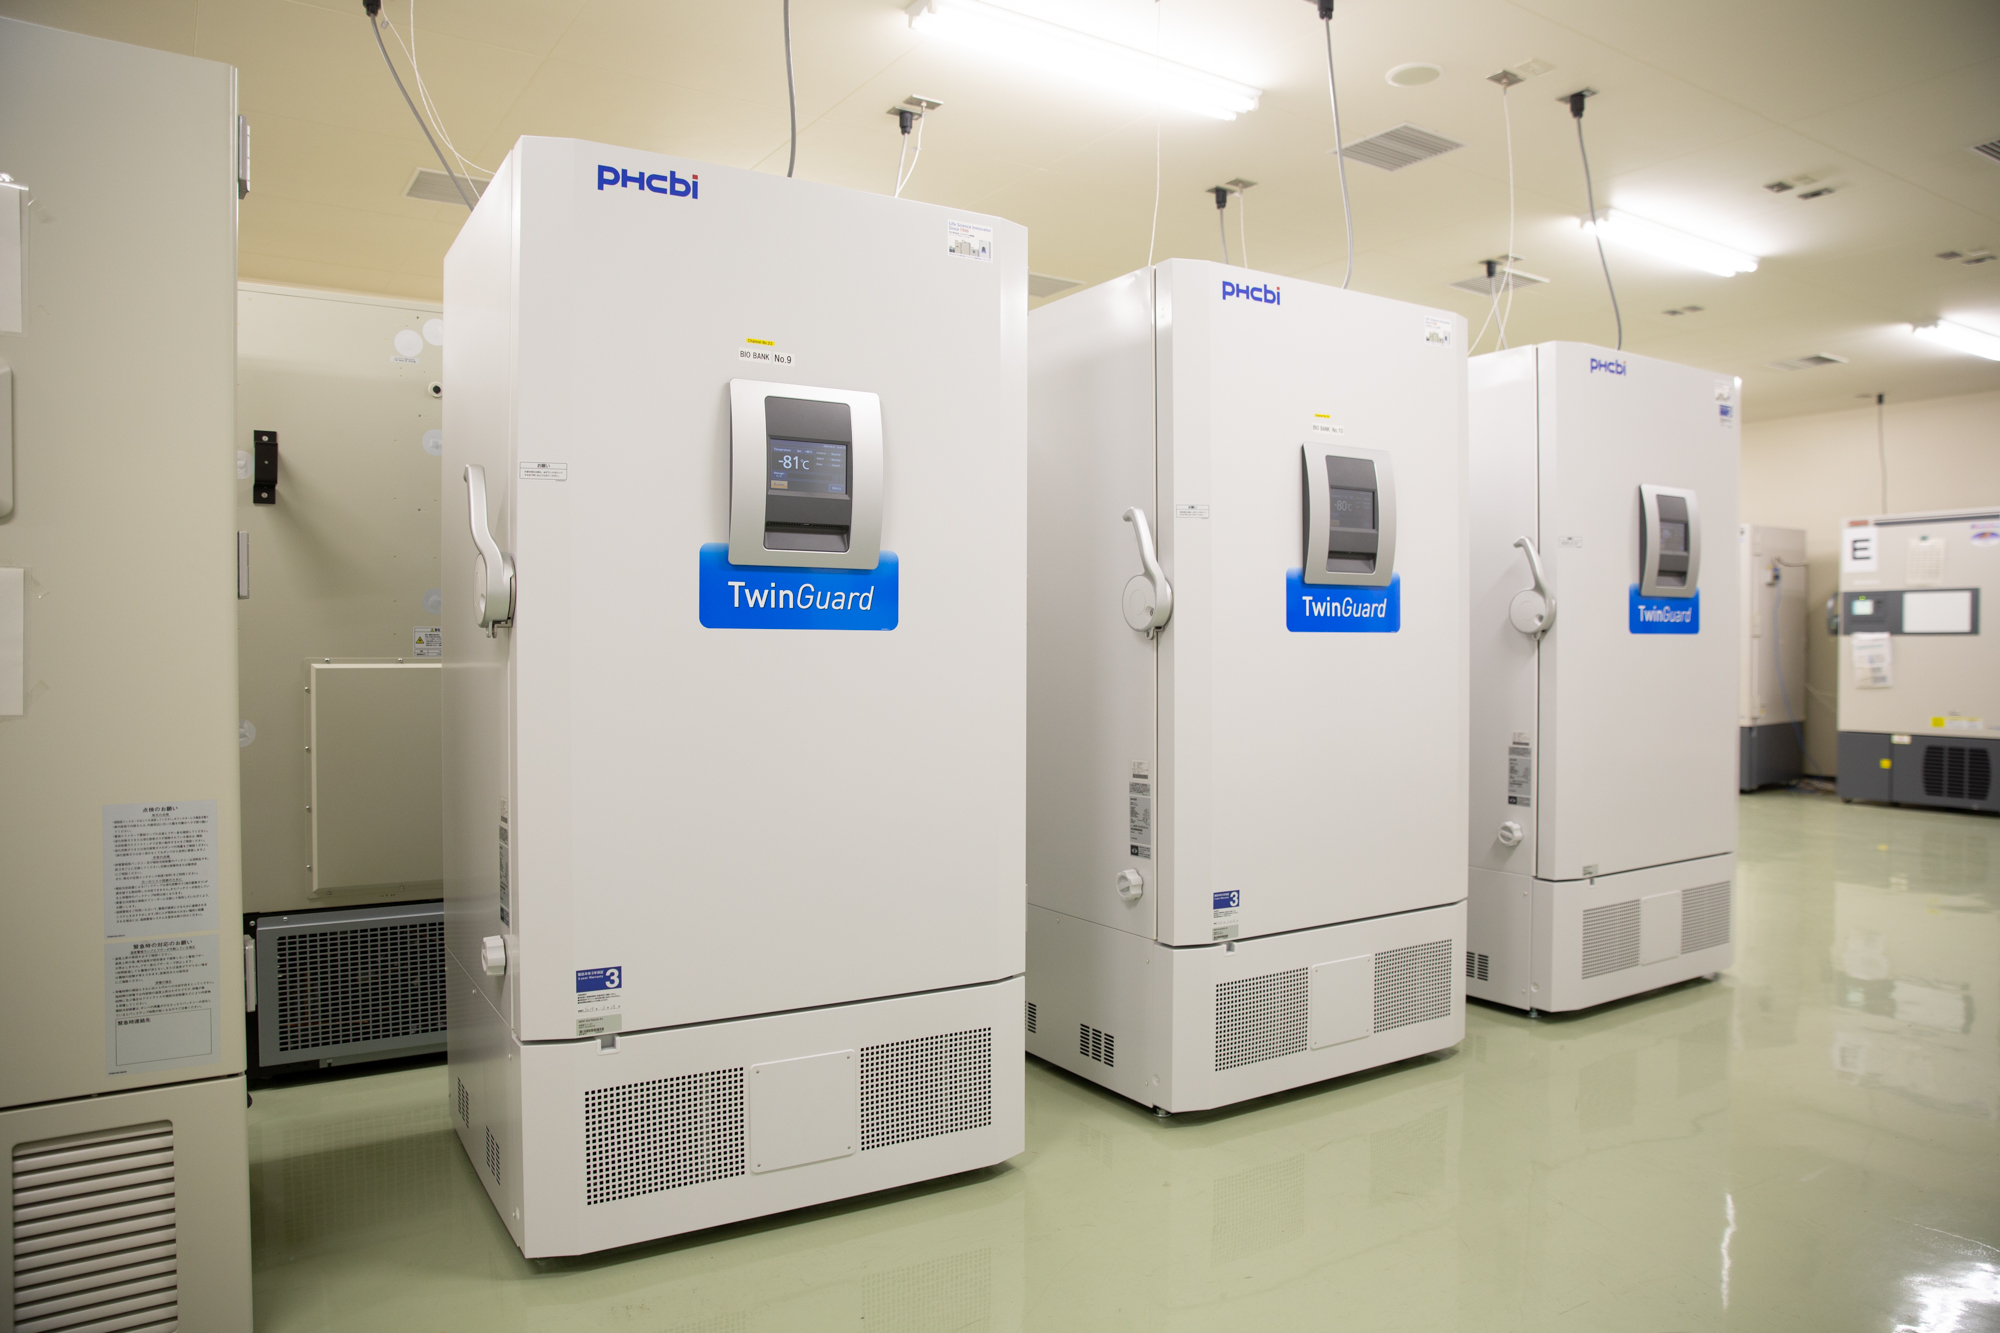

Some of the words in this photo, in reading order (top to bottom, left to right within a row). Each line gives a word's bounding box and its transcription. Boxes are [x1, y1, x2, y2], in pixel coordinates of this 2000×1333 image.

[740, 350, 751, 359] BIO
[752, 352, 770, 361] BANK
[774, 353, 792, 364] No.9
[1852, 538, 1871, 560] E
[727, 581, 875, 611] TwinGuard
[1302, 596, 1387, 618] TwinGuard
[1637, 605, 1693, 623] TwinGuard
[1229, 891, 1239, 907] 3
[133, 940, 193, 949] 緊急時の対応のお願い
[605, 968, 620, 988] 3
